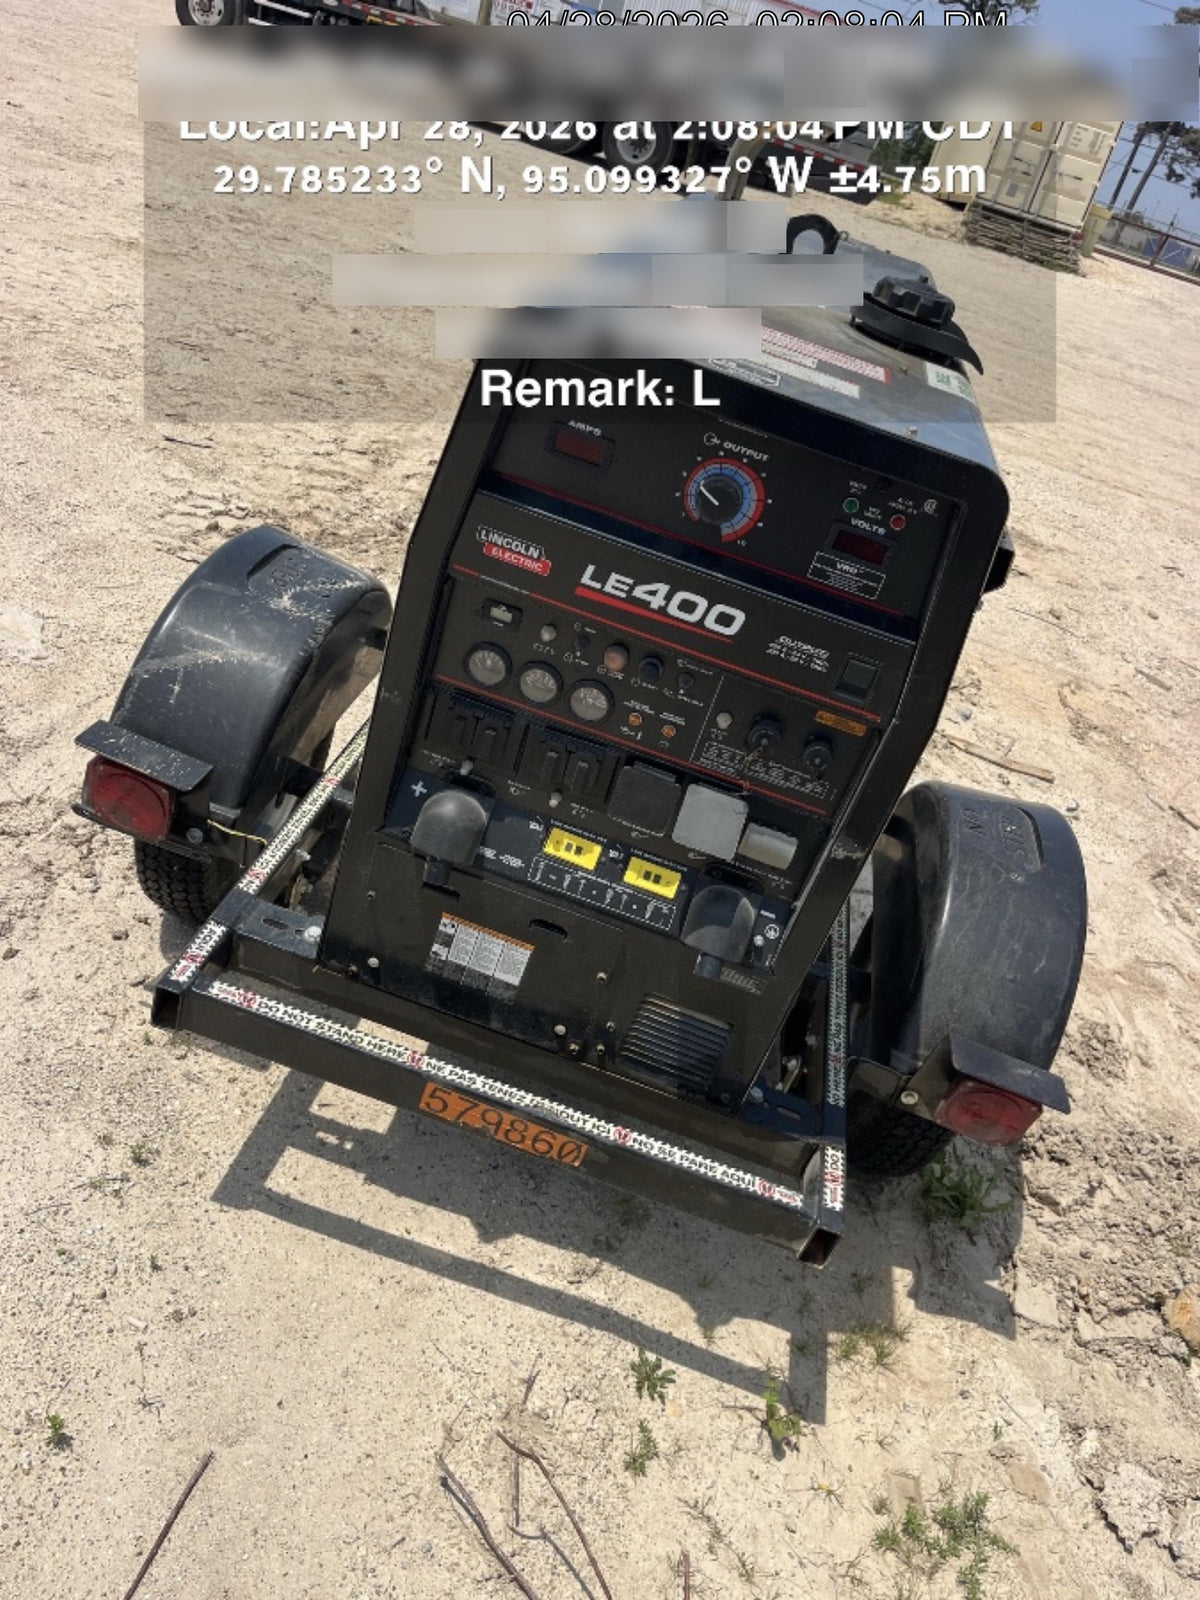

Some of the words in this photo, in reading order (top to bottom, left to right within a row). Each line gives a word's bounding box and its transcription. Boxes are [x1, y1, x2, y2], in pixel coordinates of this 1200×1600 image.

[723, 440, 769, 461] OUTPUT
[480, 528, 542, 560] LINCOLN
[490, 546, 544, 572] ELECTRIC
[579, 564, 746, 637] LE400
[257, 999, 279, 1014] DO
[281, 1008, 312, 1026] NOT
[314, 1020, 363, 1044] STAND
[365, 1039, 406, 1060] HERE
[448, 1067, 478, 1085] PAS
[631, 1136, 654, 1150] NO
